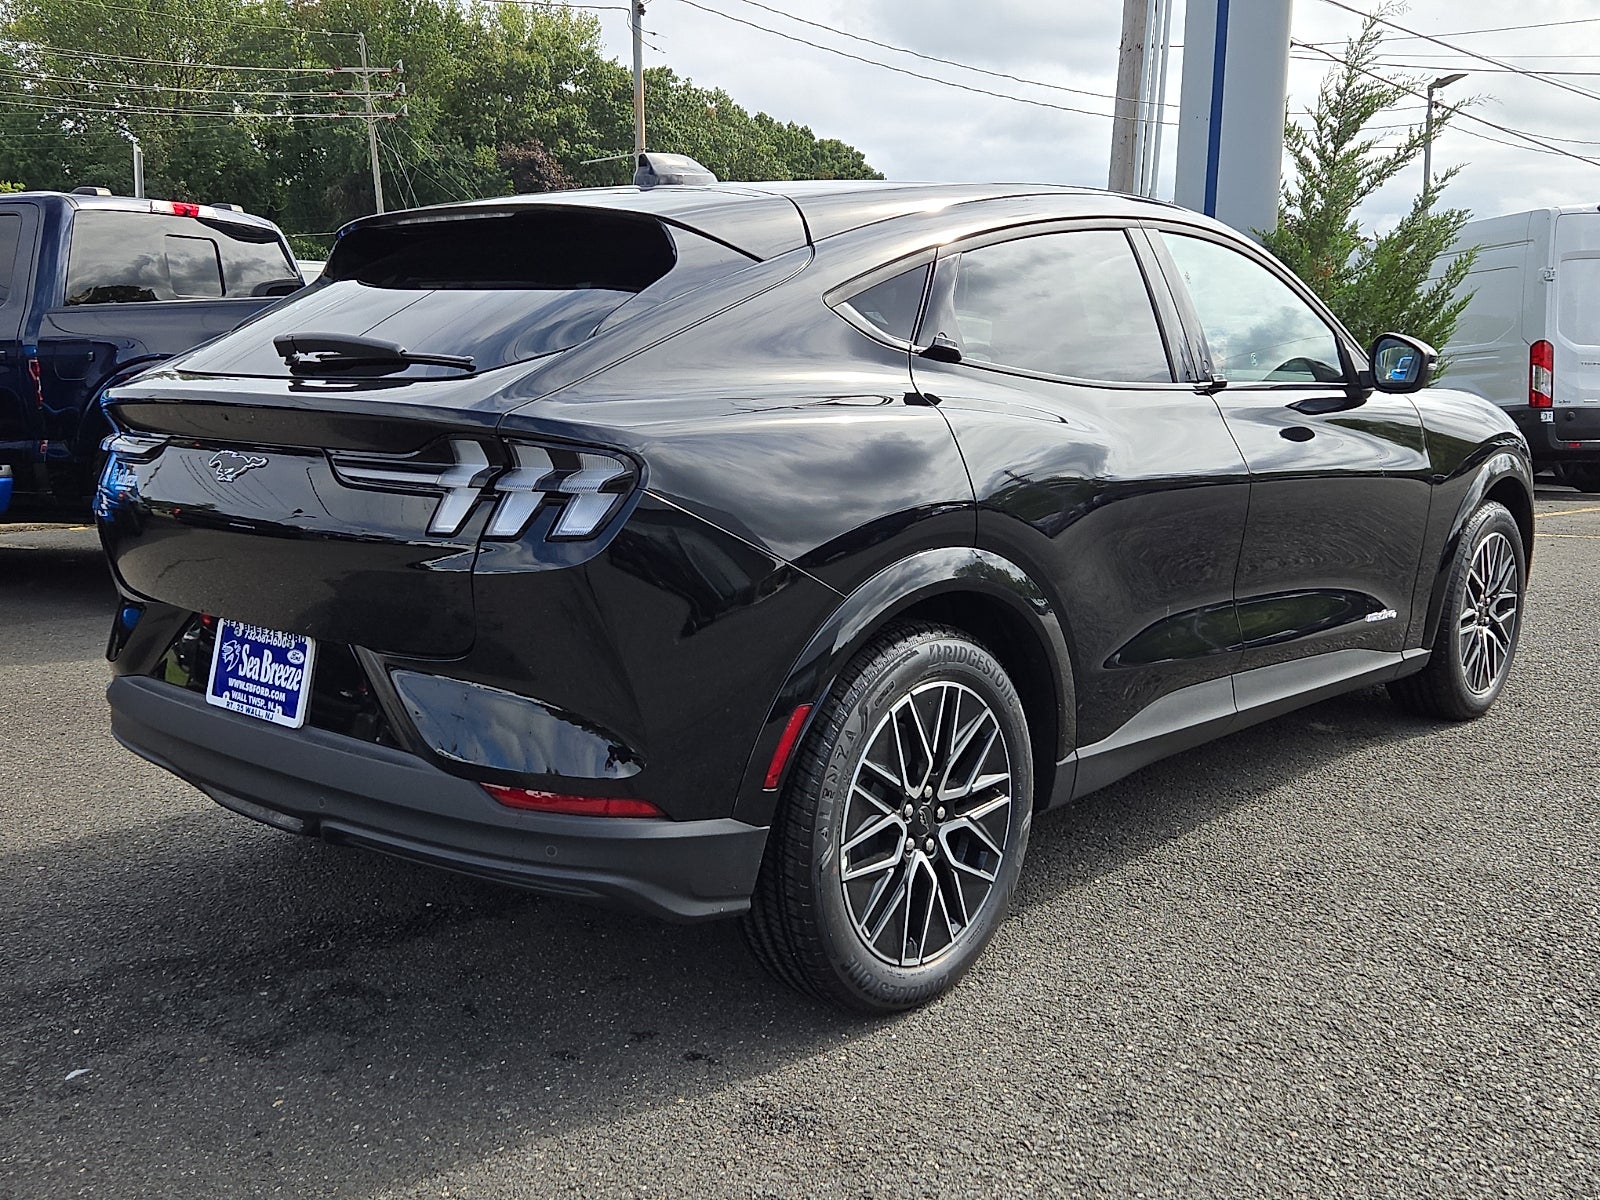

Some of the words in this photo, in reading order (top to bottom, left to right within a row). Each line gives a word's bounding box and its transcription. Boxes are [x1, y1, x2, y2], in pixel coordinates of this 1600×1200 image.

[224, 619, 241, 628] SEA
[244, 624, 279, 637] BREEZE
[282, 632, 306, 644] FORD
[238, 644, 260, 680] Sea
[260, 649, 302, 691] Breeze
[928, 644, 1016, 706] BRIDGESTONE
[228, 678, 286, 702] WWW.SBFORD.COM
[231, 690, 248, 702] WALL
[265, 712, 274, 720] NJ
[817, 730, 857, 842] ALENZA
